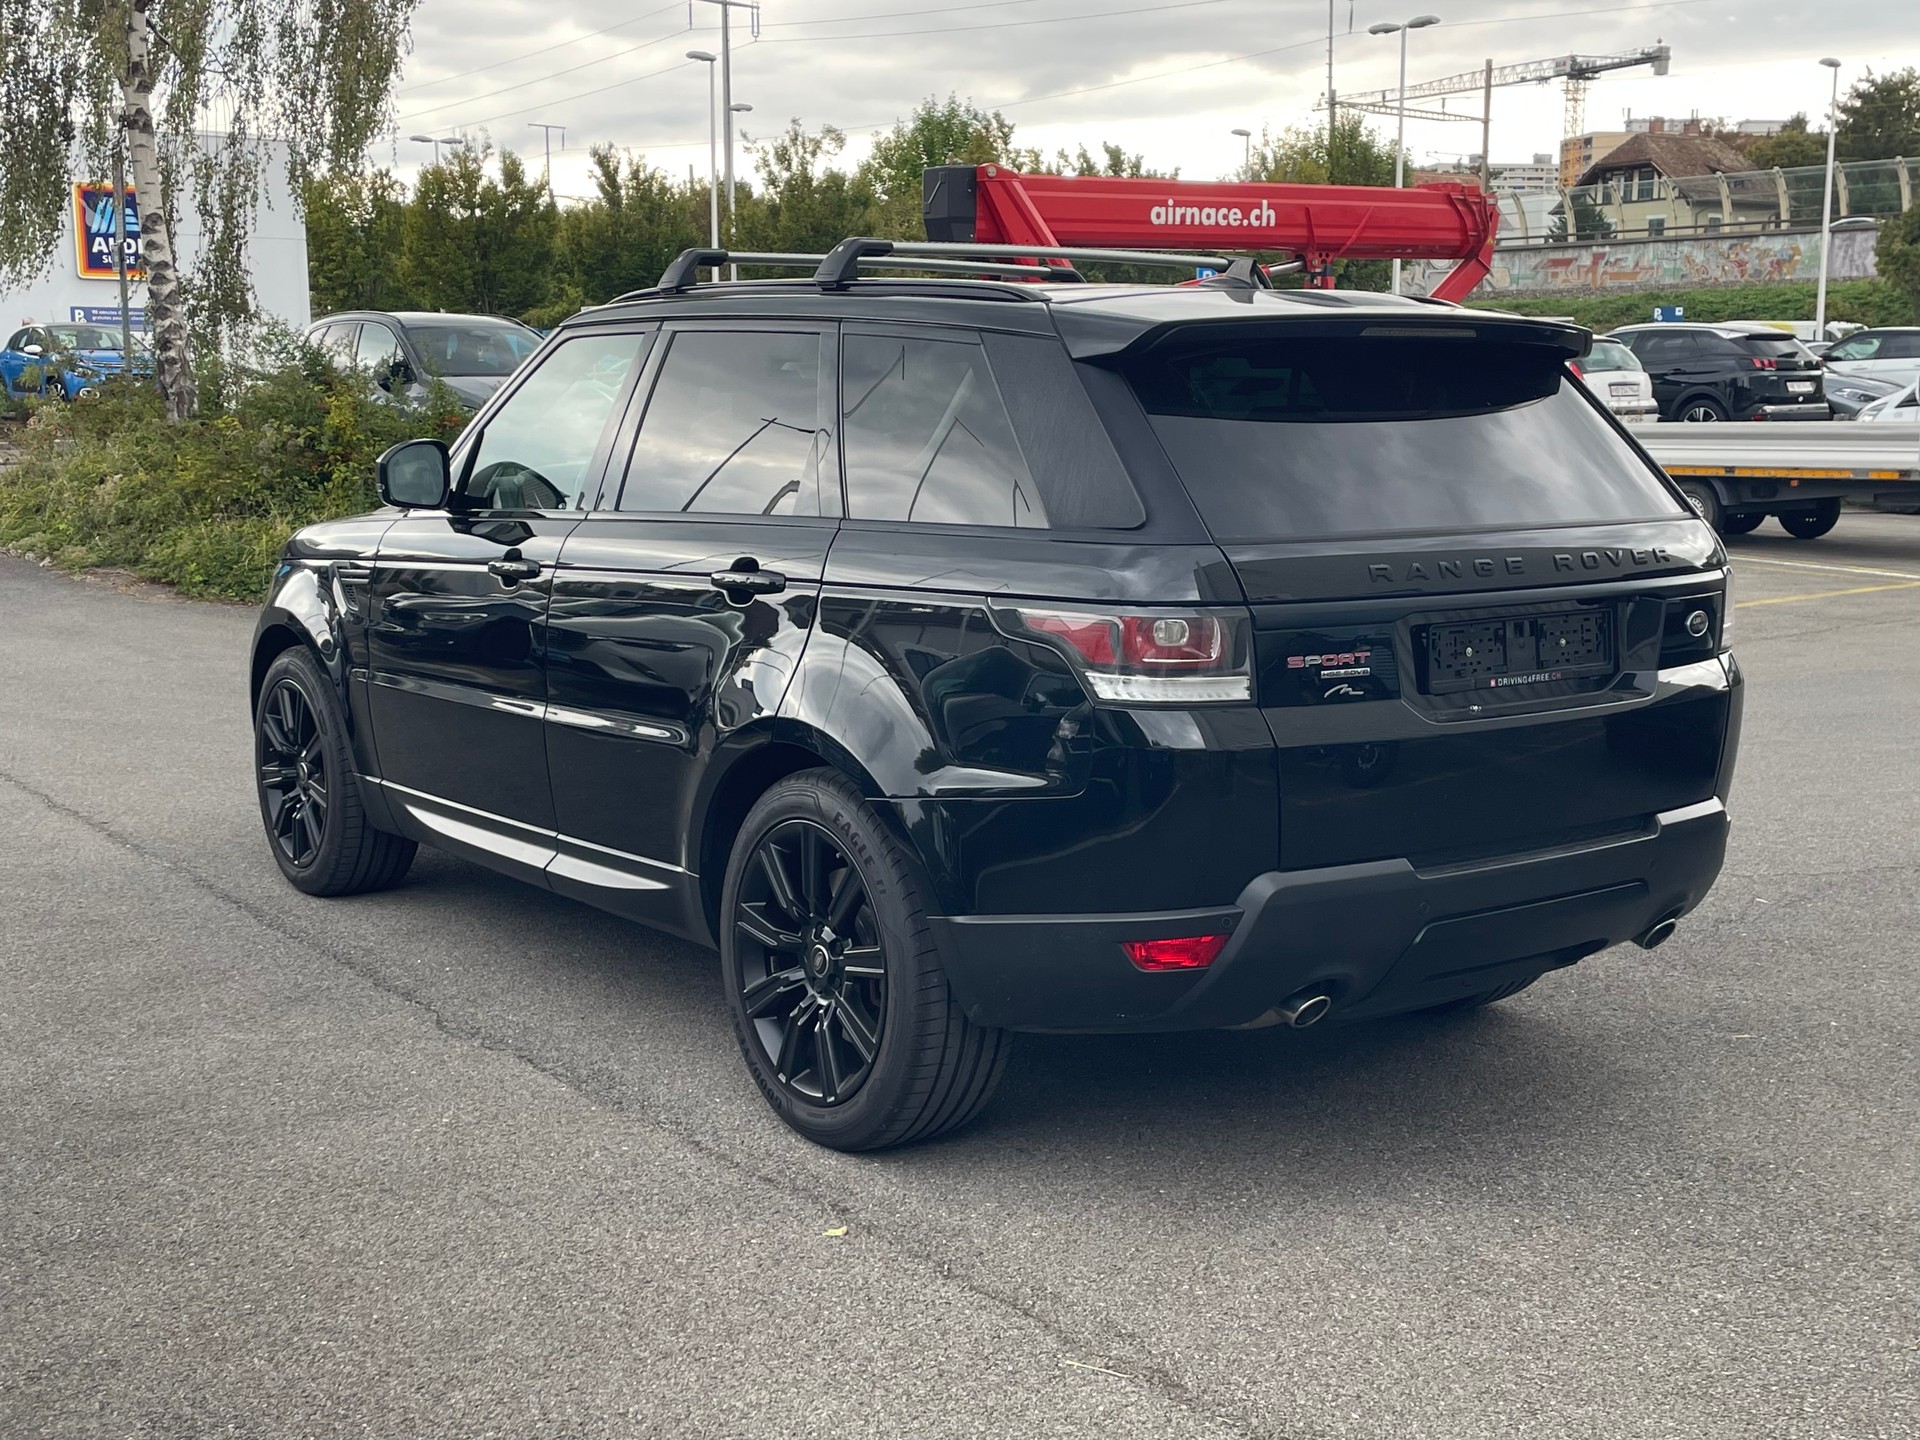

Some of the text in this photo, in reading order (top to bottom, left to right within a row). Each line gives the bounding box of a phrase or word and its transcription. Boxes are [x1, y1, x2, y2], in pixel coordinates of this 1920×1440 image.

[1150, 198, 1276, 227] airnace.ch
[75, 309, 84, 323] P
[1367, 547, 1672, 584] RANGE ROVER
[1287, 651, 1371, 669] SPORT
[833, 811, 875, 868] EAGLE
